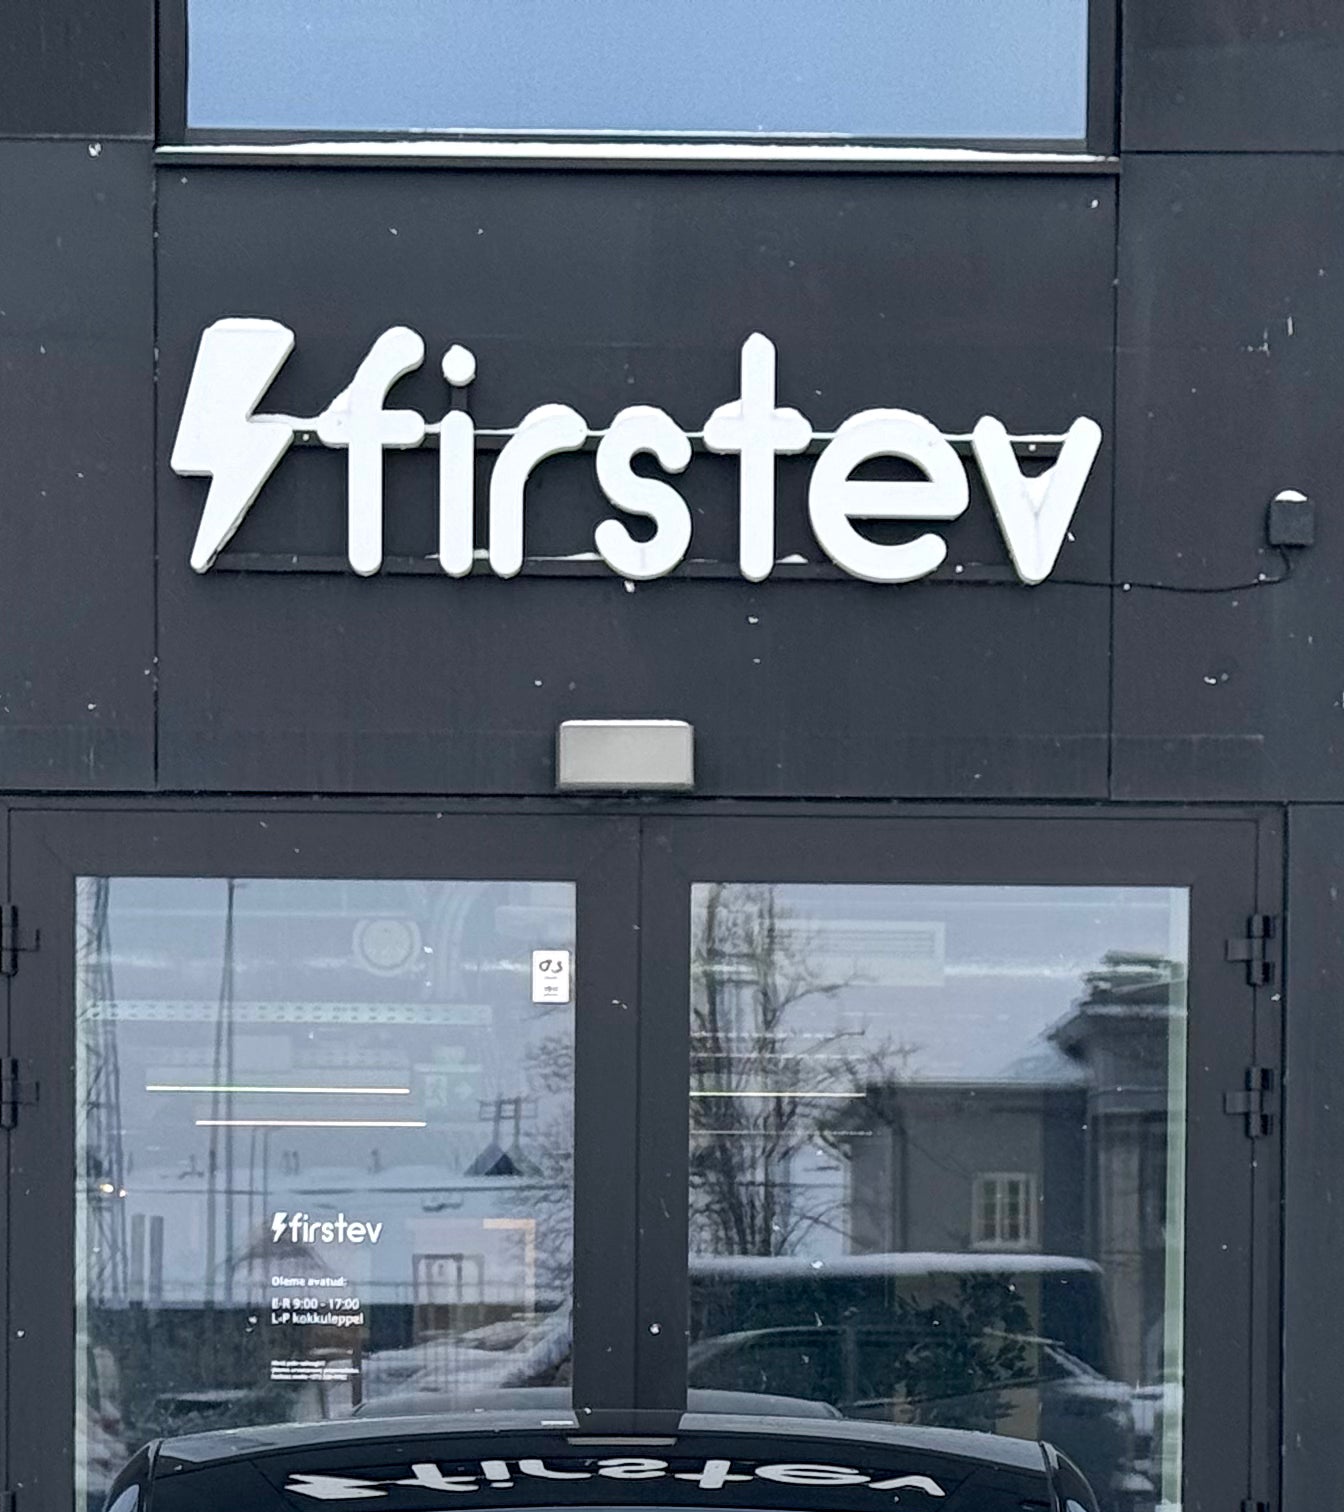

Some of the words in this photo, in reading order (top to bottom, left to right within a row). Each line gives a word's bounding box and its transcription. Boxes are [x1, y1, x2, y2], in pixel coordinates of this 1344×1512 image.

[317, 325, 1103, 584] firstev
[289, 1212, 384, 1243] firstev
[271, 1276, 306, 1287] Oleme
[307, 1276, 348, 1287] avatud:
[292, 1297, 318, 1310] 9:00
[328, 1297, 360, 1310] 17:00
[271, 1312, 291, 1325] L-P
[292, 1312, 364, 1328] kokkuleppel
